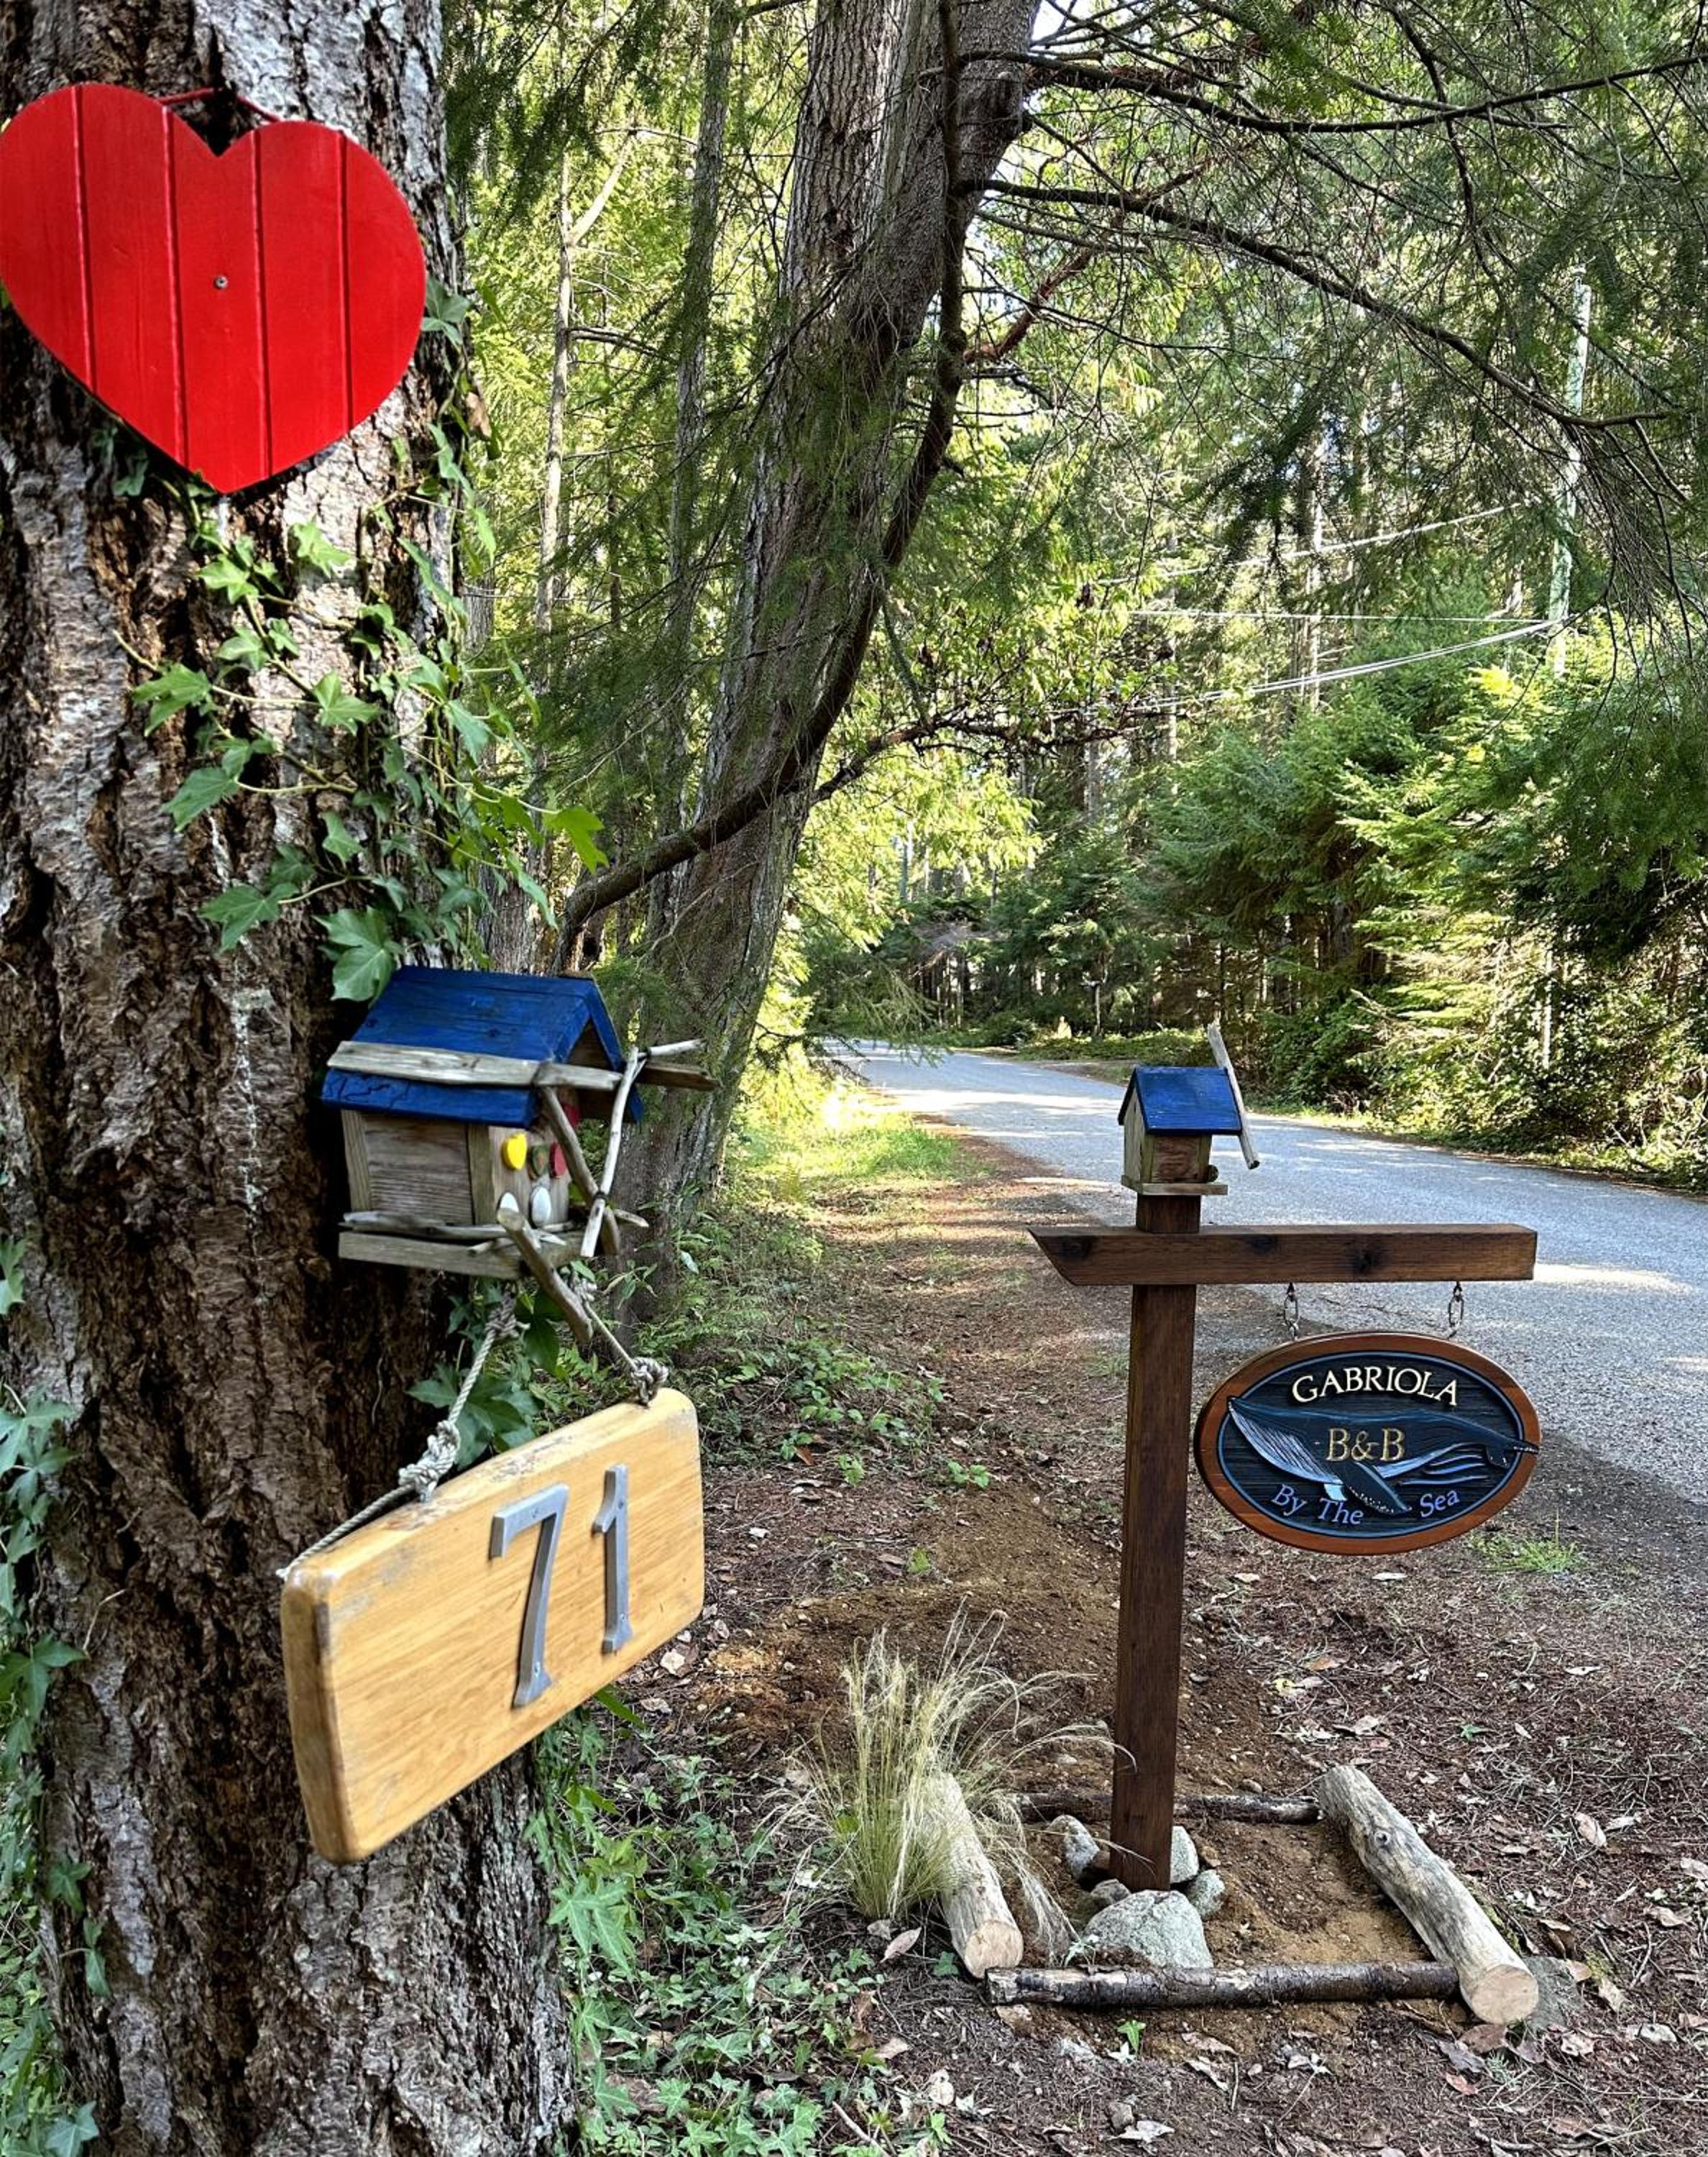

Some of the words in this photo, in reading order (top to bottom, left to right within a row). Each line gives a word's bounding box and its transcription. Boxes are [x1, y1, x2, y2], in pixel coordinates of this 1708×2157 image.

[1293, 1366, 1457, 1406] GABRIOLA
[1327, 1428, 1405, 1462] B&B
[1272, 1484, 1306, 1516] By
[1318, 1498, 1364, 1524] The
[1420, 1489, 1460, 1519] Sea
[490, 1464, 632, 1708] 71
